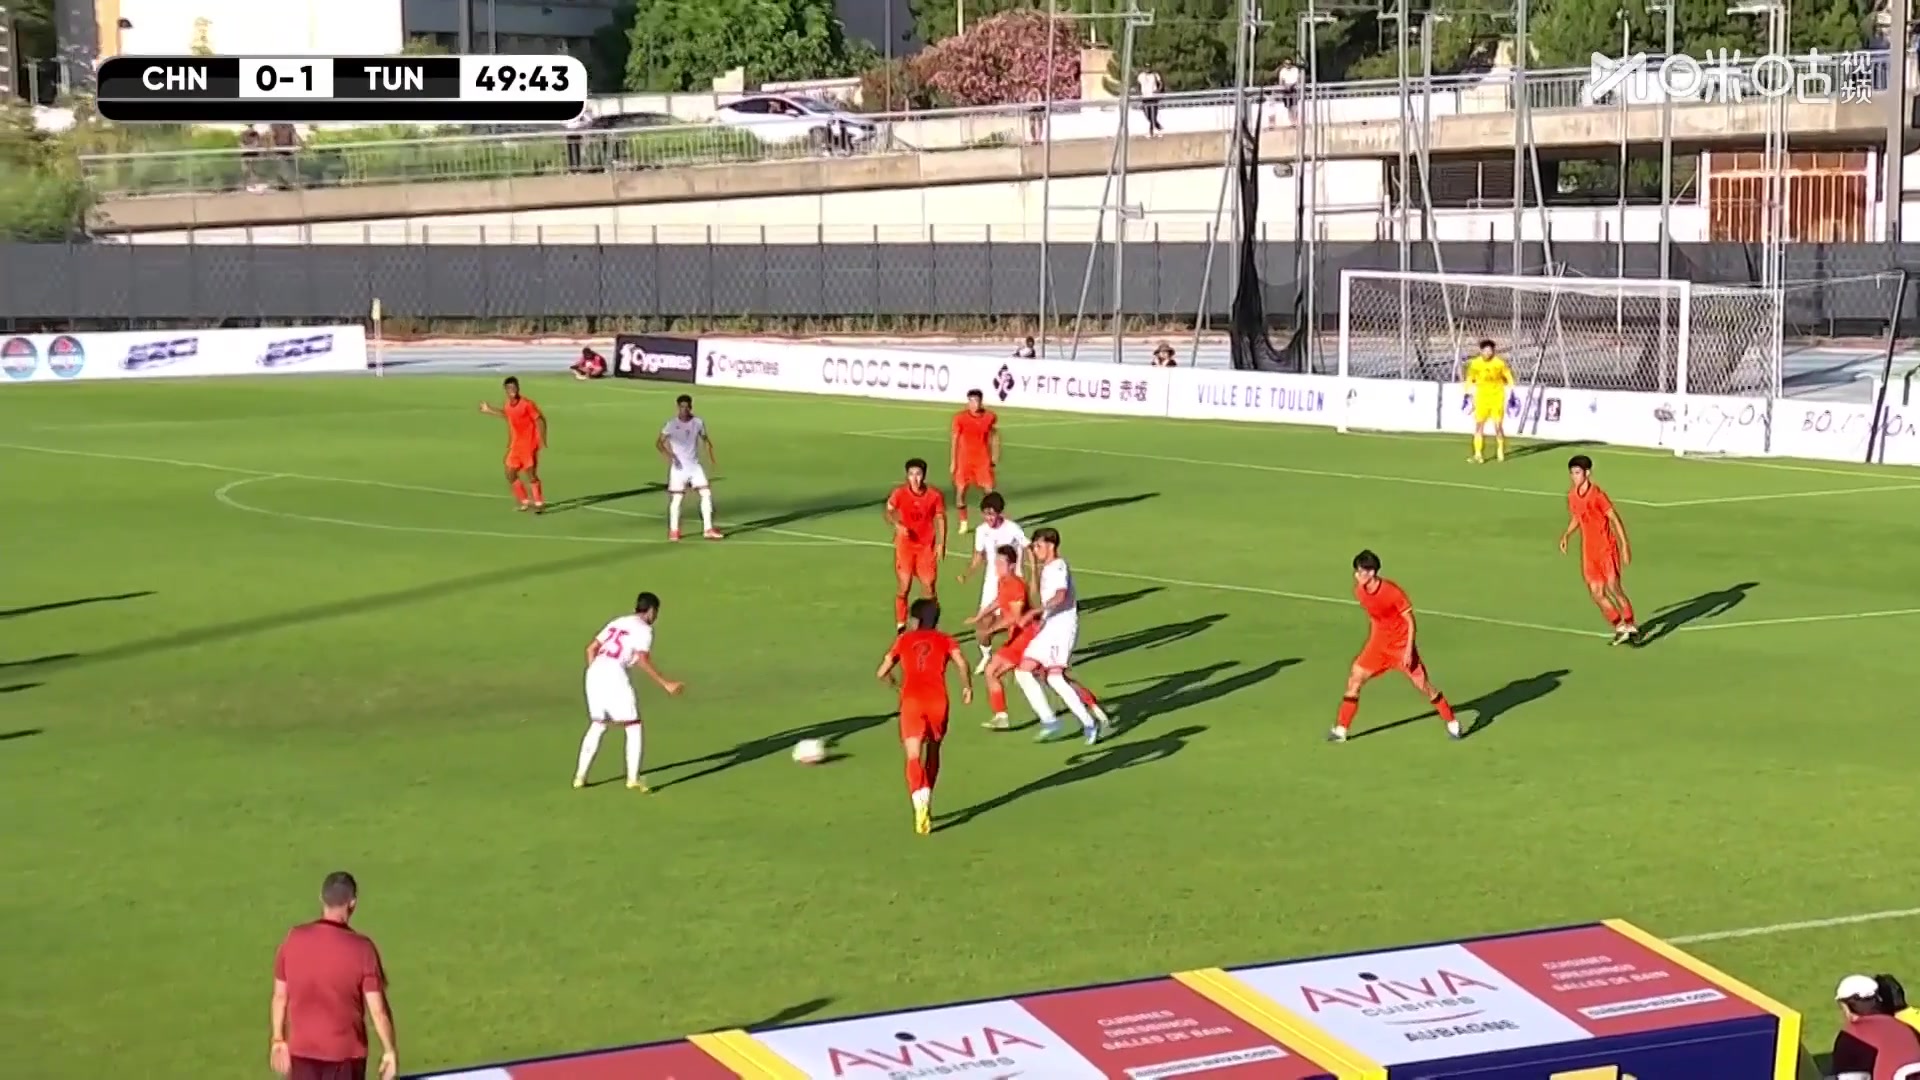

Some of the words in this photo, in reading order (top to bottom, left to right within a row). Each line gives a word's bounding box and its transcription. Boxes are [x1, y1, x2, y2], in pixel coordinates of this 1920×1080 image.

[631, 347, 692, 374] Cygames
[717, 354, 779, 379] Cygames
[897, 362, 950, 391] ZERO
[1019, 375, 1032, 393] Y
[1036, 375, 1061, 395] FIT
[1066, 377, 1111, 400] CLUB
[1198, 384, 1238, 408] VILLE
[1245, 386, 1262, 408] DE
[1269, 387, 1326, 412] TOULON
[598, 626, 630, 660] 25
